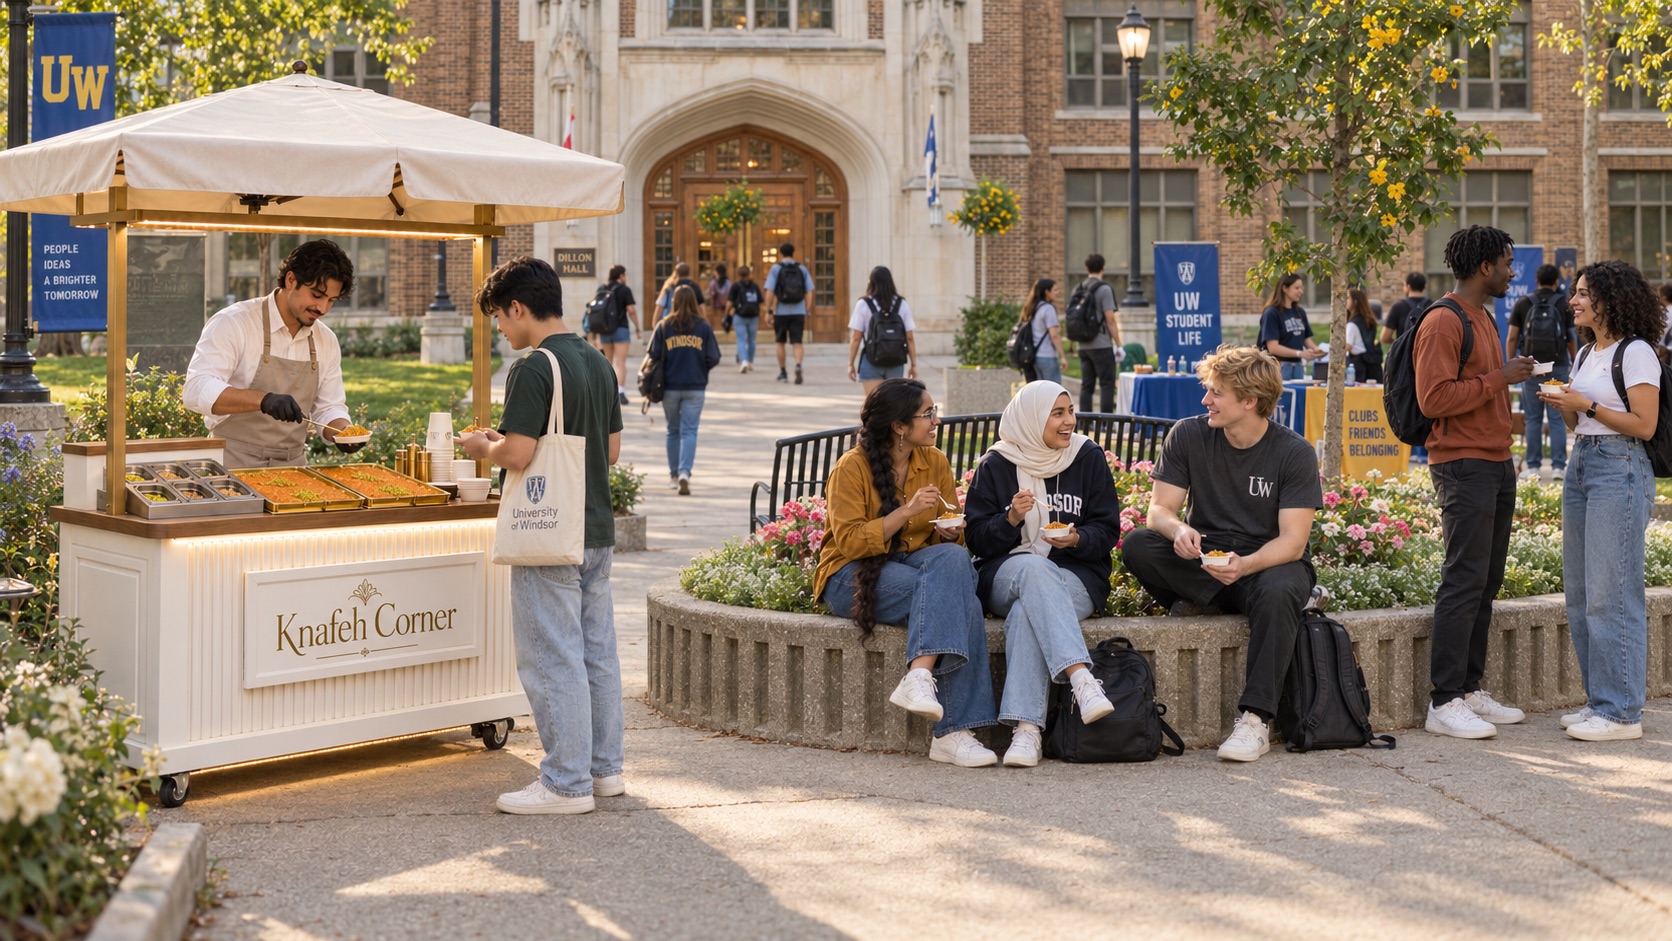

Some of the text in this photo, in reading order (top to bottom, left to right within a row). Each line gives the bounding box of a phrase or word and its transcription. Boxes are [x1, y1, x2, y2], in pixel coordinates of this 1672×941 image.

[40, 54, 109, 111] UW
[43, 244, 79, 254] PEOPLE
[43, 259, 71, 270] IDEAS
[557, 253, 593, 263] DILLON
[562, 264, 589, 274] HALL
[43, 274, 97, 286] A BRIGHTER
[43, 289, 99, 300] TOMORROW
[1173, 292, 1200, 311] UW
[1165, 314, 1213, 328] STUDENT
[665, 334, 703, 351] WINDSOR
[1177, 331, 1202, 346] LIFE
[1348, 409, 1379, 422] CLUBS
[1348, 426, 1386, 440] FRIENDS
[1349, 443, 1399, 457] BELONGING
[1248, 475, 1274, 499] UW
[512, 506, 559, 519] University
[511, 519, 559, 531] of Windsor
[275, 602, 457, 657] Knafeh Corner
